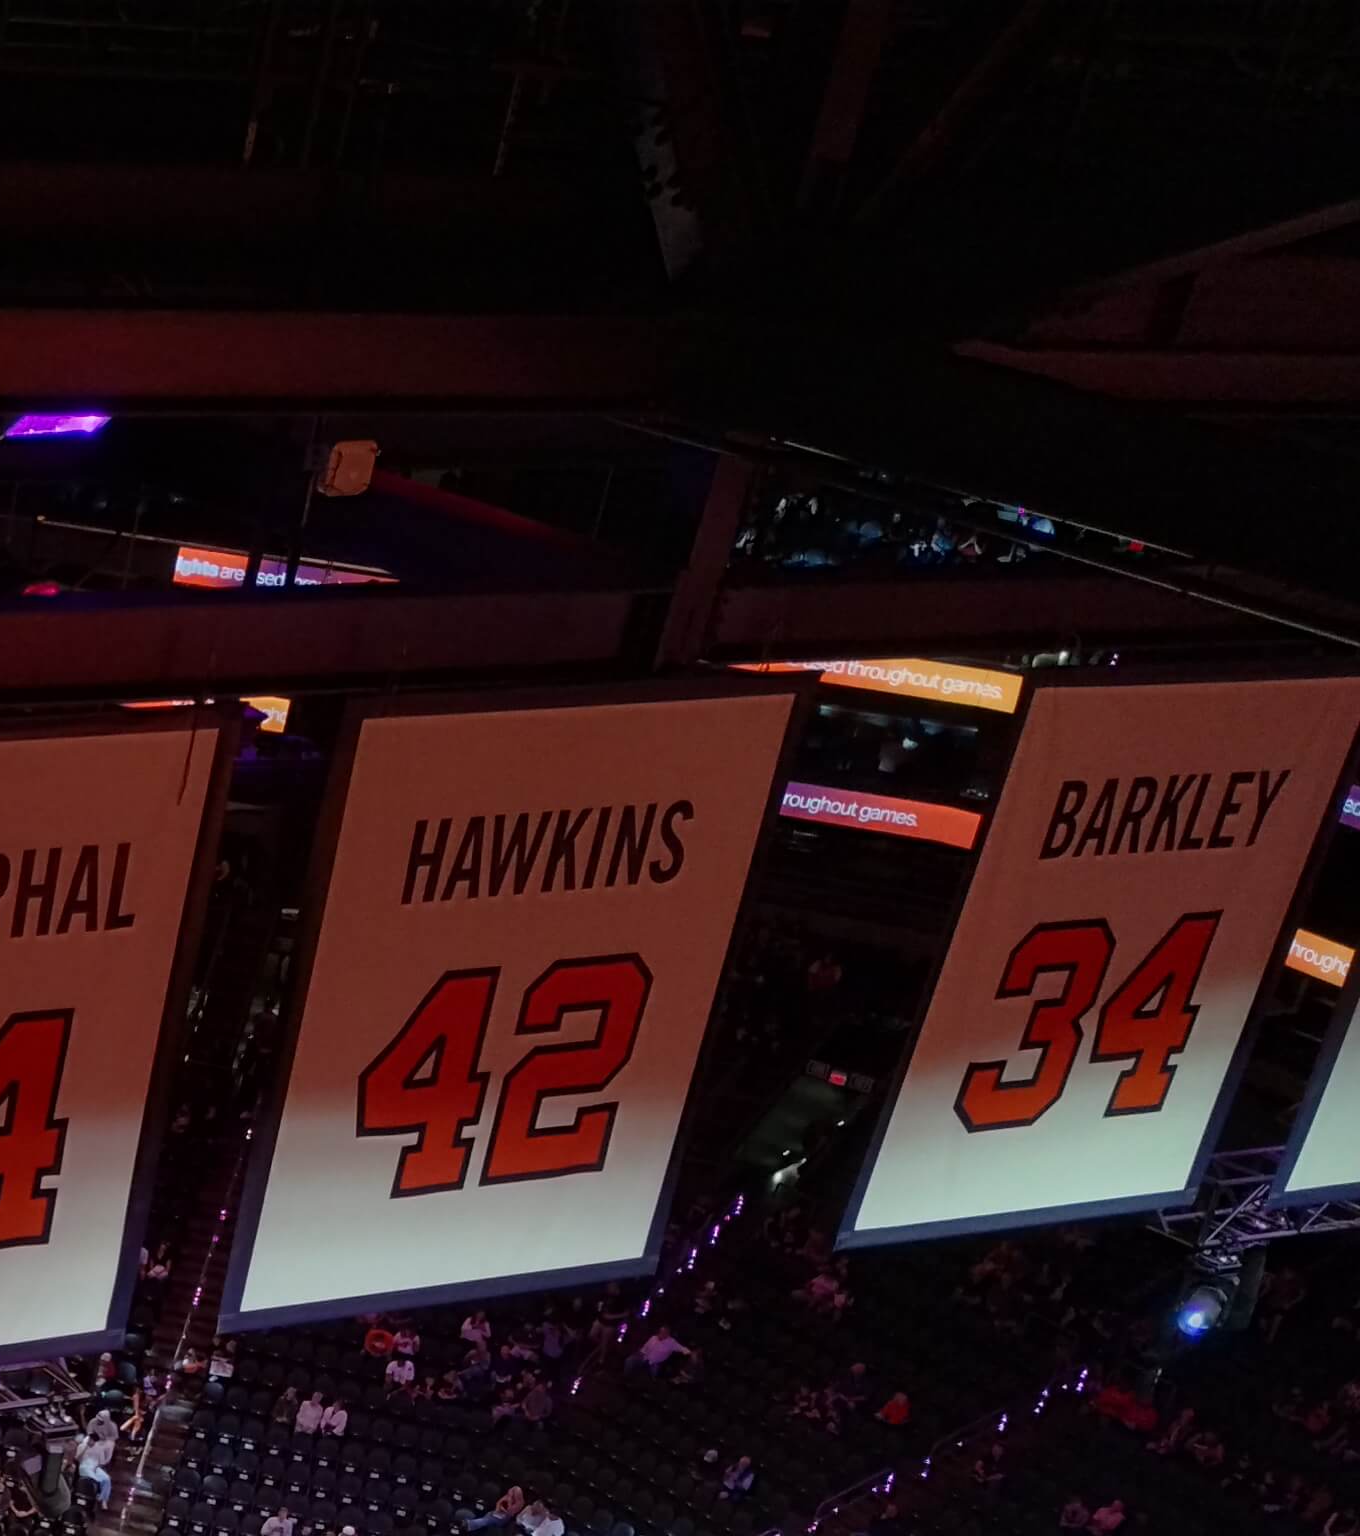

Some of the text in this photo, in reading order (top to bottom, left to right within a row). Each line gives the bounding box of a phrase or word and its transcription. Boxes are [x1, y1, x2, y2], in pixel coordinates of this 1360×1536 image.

[220, 567, 246, 582] are
[256, 571, 287, 588] sed
[847, 660, 941, 689] throughout
[782, 792, 859, 818] roughout
[1038, 769, 1292, 860] BARKLEY
[401, 800, 695, 905] HAWKINS
[953, 909, 1224, 1133] 34
[356, 952, 654, 1199] 42
